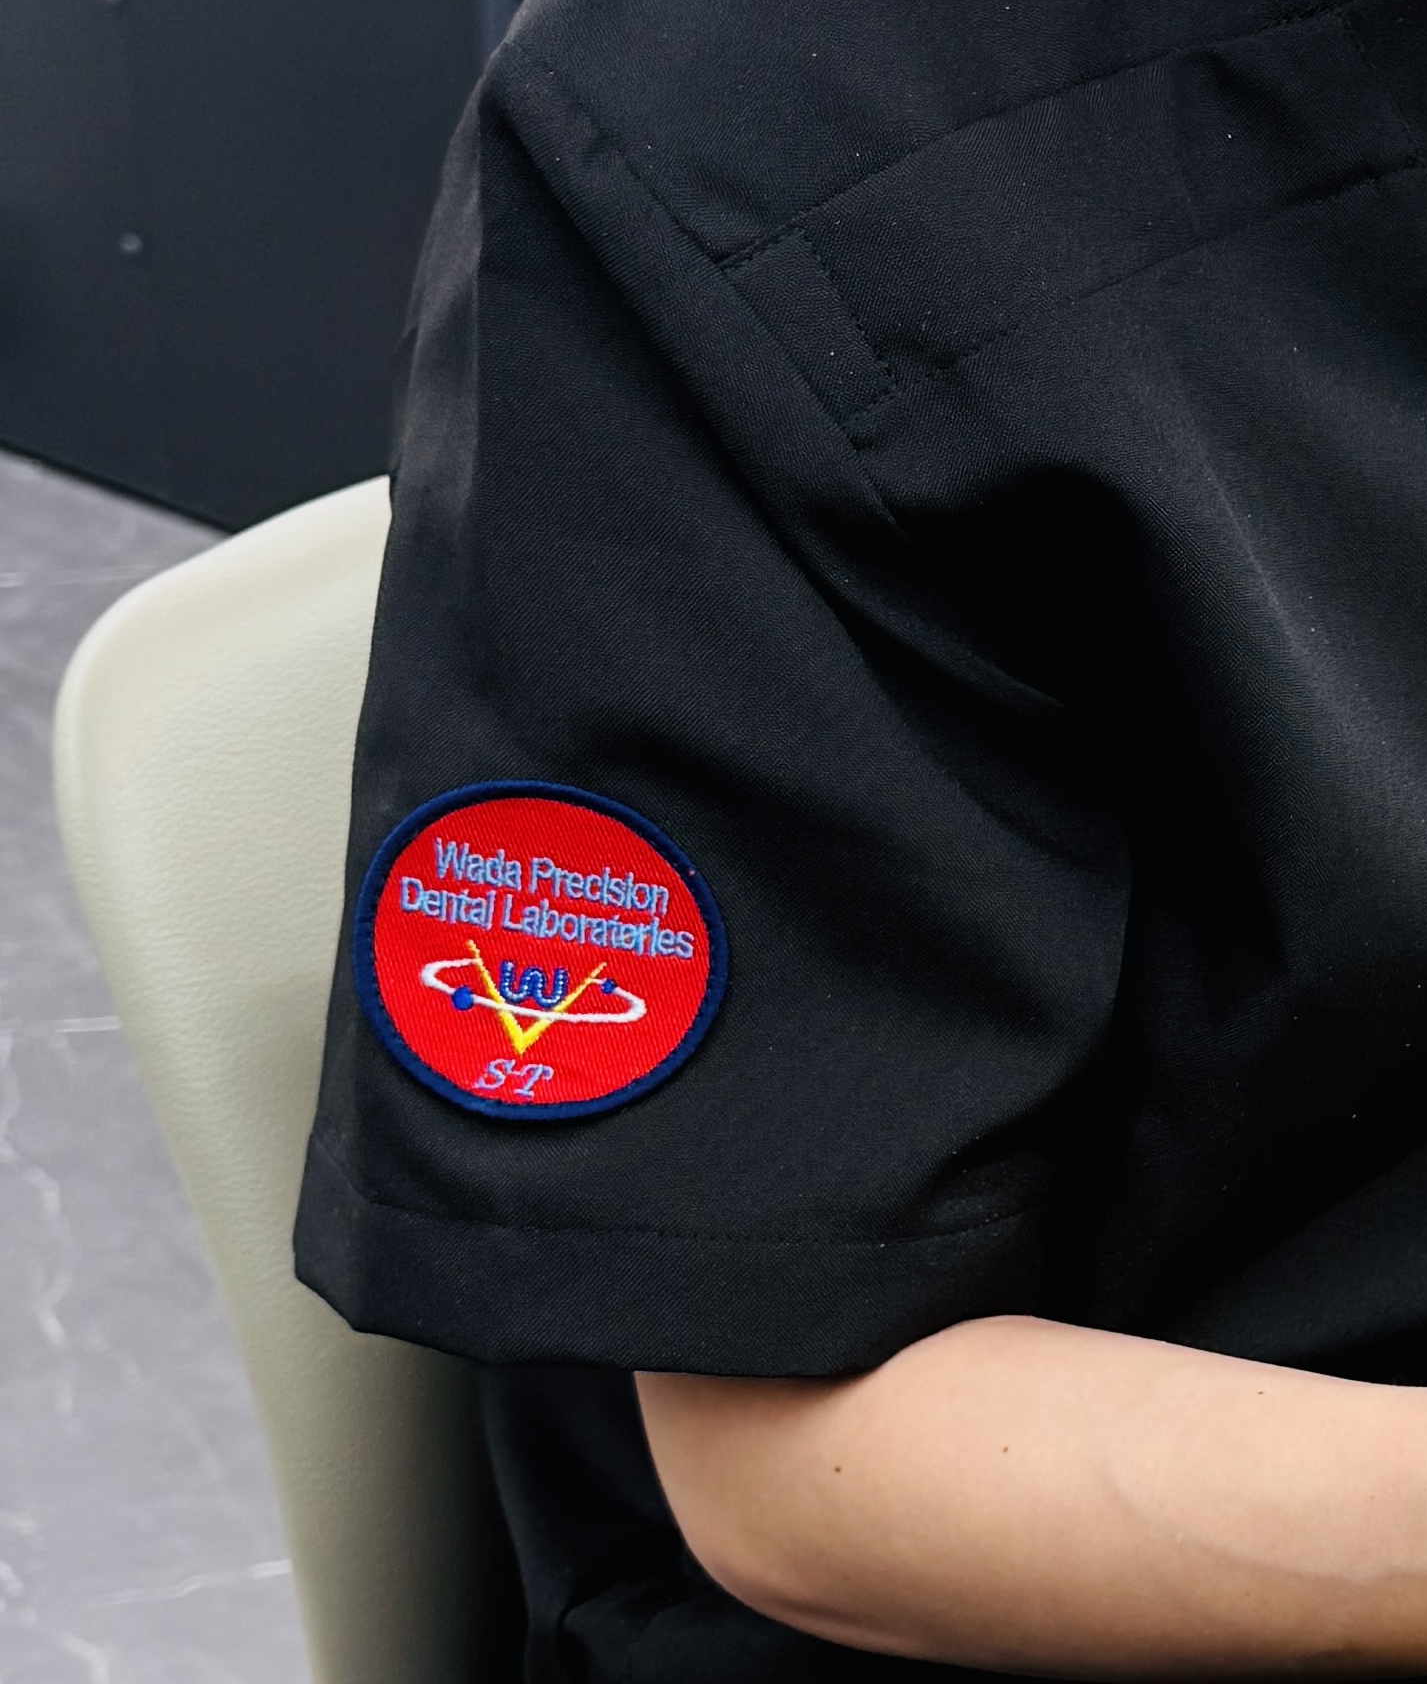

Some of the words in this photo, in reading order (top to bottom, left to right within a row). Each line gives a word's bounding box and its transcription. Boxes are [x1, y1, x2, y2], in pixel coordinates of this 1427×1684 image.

[434, 836, 522, 891] Wada
[529, 856, 670, 917] Precision
[400, 876, 496, 930] Dental
[501, 893, 695, 960] Laboratories
